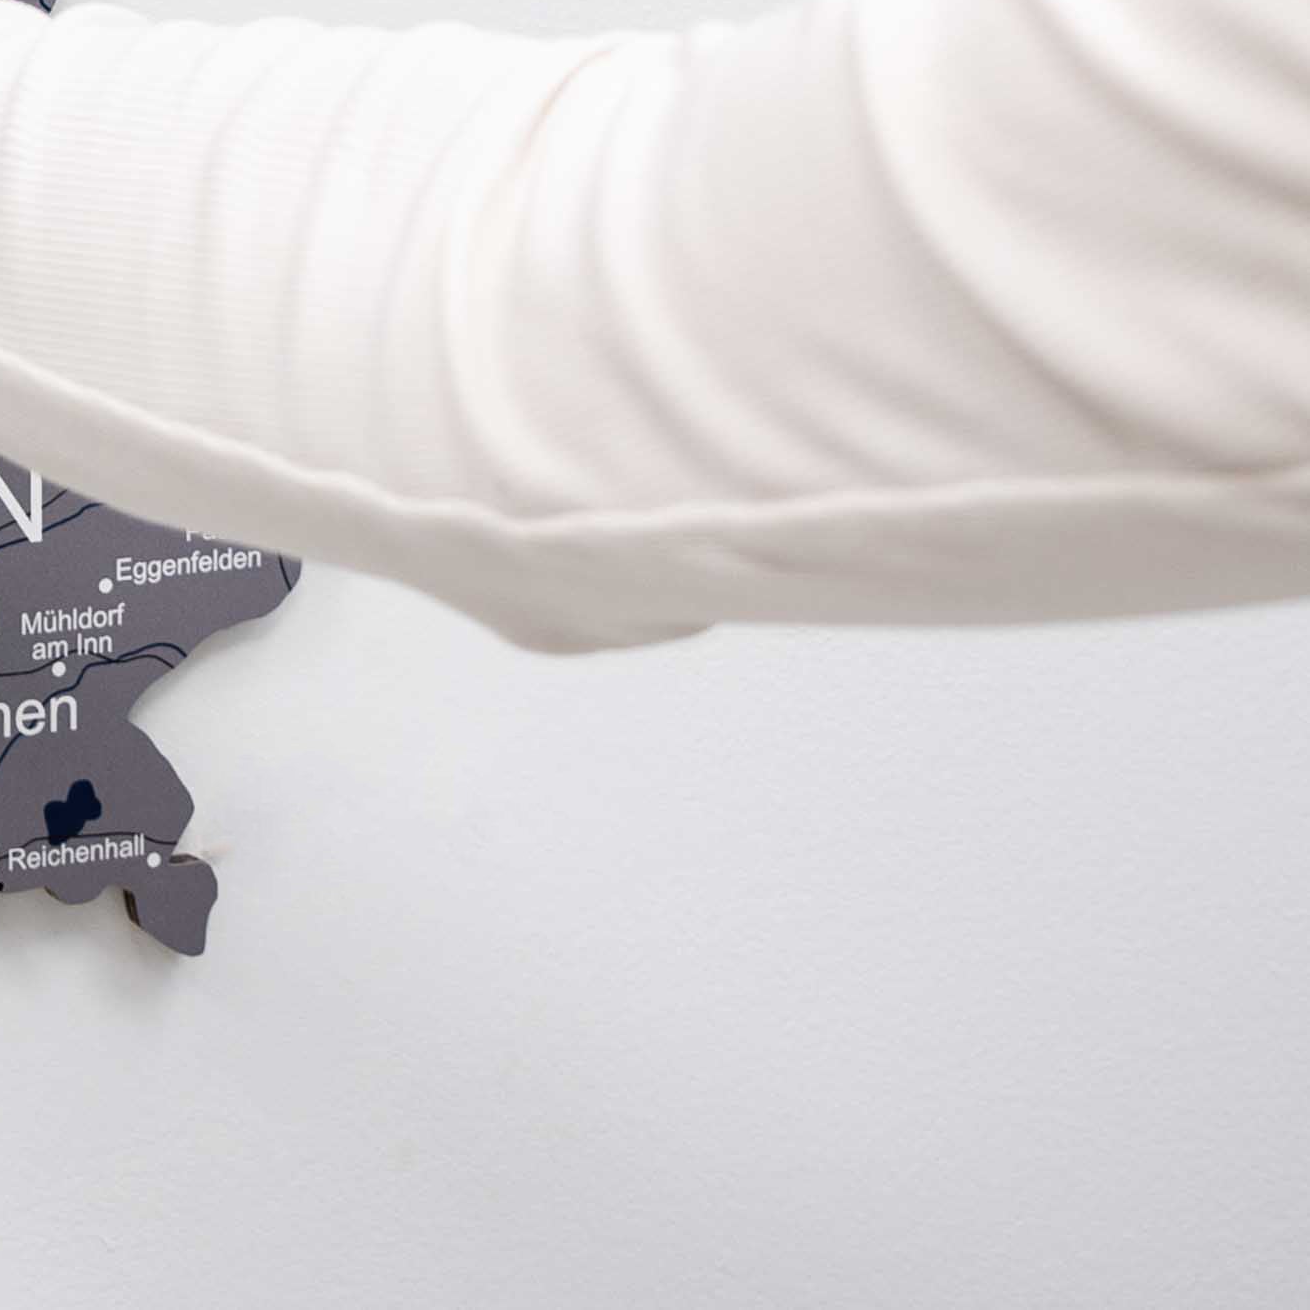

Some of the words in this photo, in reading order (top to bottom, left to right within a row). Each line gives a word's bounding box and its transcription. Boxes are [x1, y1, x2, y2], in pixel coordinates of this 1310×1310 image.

[117, 548, 261, 584] Eggenfelden
[22, 603, 125, 635] Mühldorf
[31, 635, 65, 661] am
[78, 633, 112, 655] Inn
